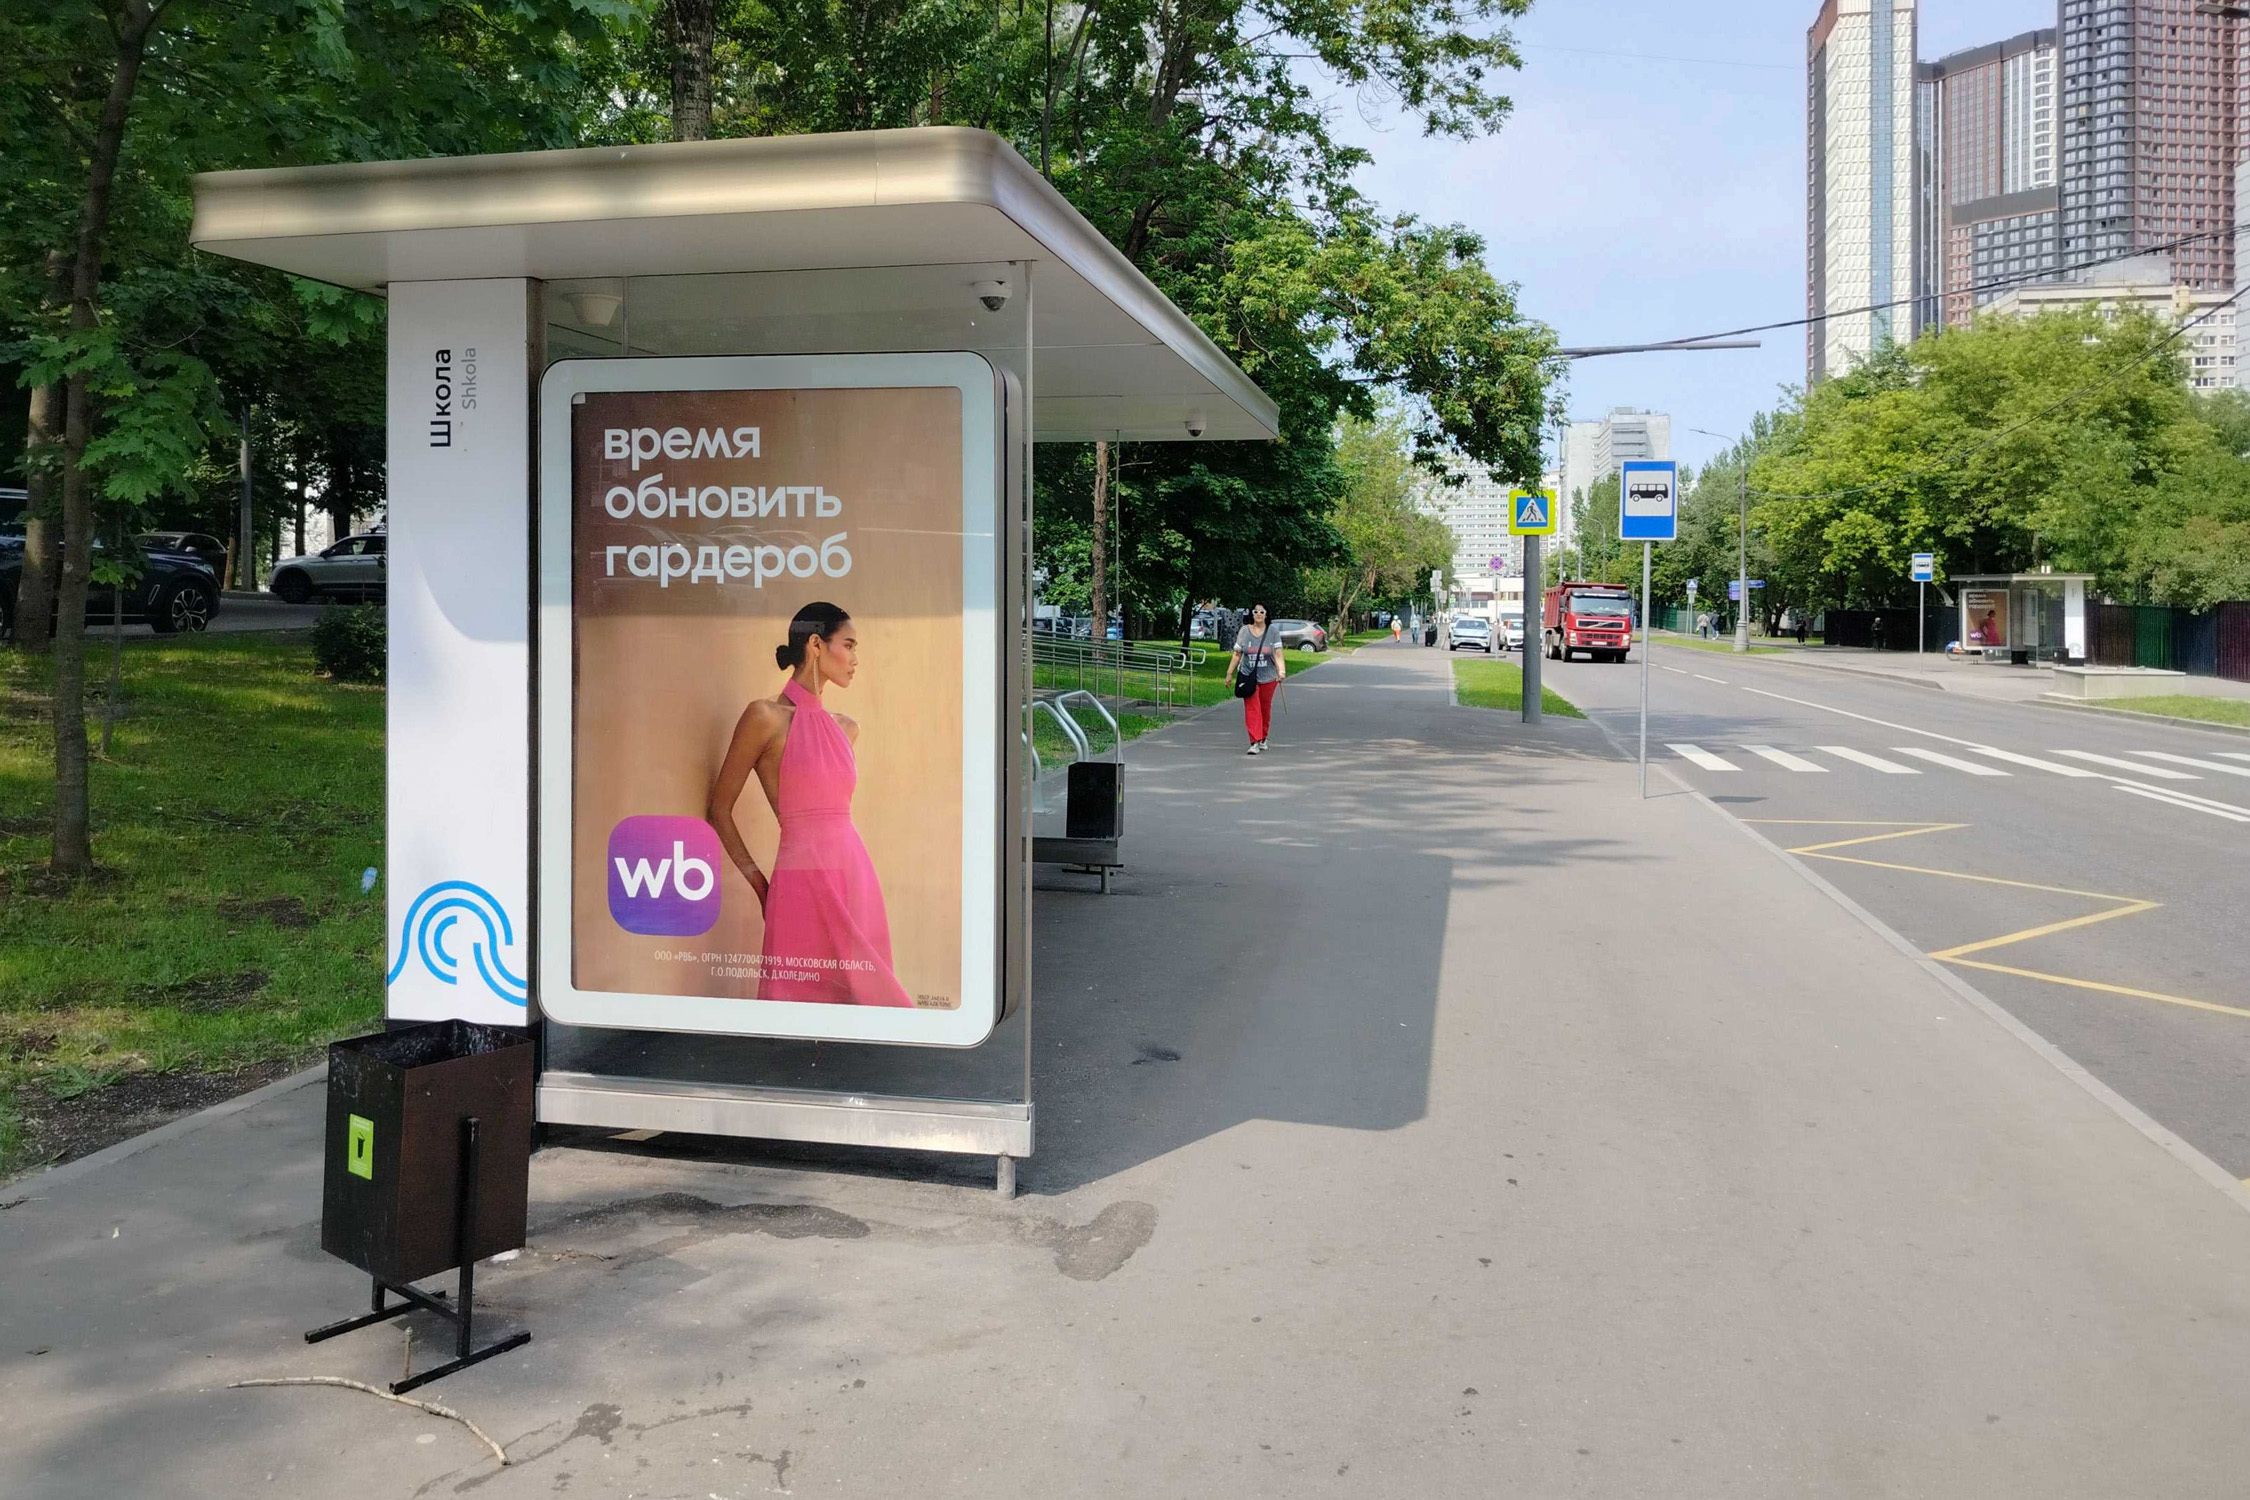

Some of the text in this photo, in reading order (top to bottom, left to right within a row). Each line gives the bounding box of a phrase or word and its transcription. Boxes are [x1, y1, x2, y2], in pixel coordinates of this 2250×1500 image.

[429, 349, 451, 448] Школа
[460, 347, 477, 410] Shkola
[604, 426, 761, 471] время
[604, 473, 842, 519] обновить
[606, 530, 852, 589] гардероб
[614, 840, 715, 901] wb
[654, 950, 672, 961] ООО
[701, 952, 722, 963] ОГРН
[785, 956, 837, 970] МОСКОВСКАЯ
[839, 959, 876, 972] ОБЛАСТЬ,
